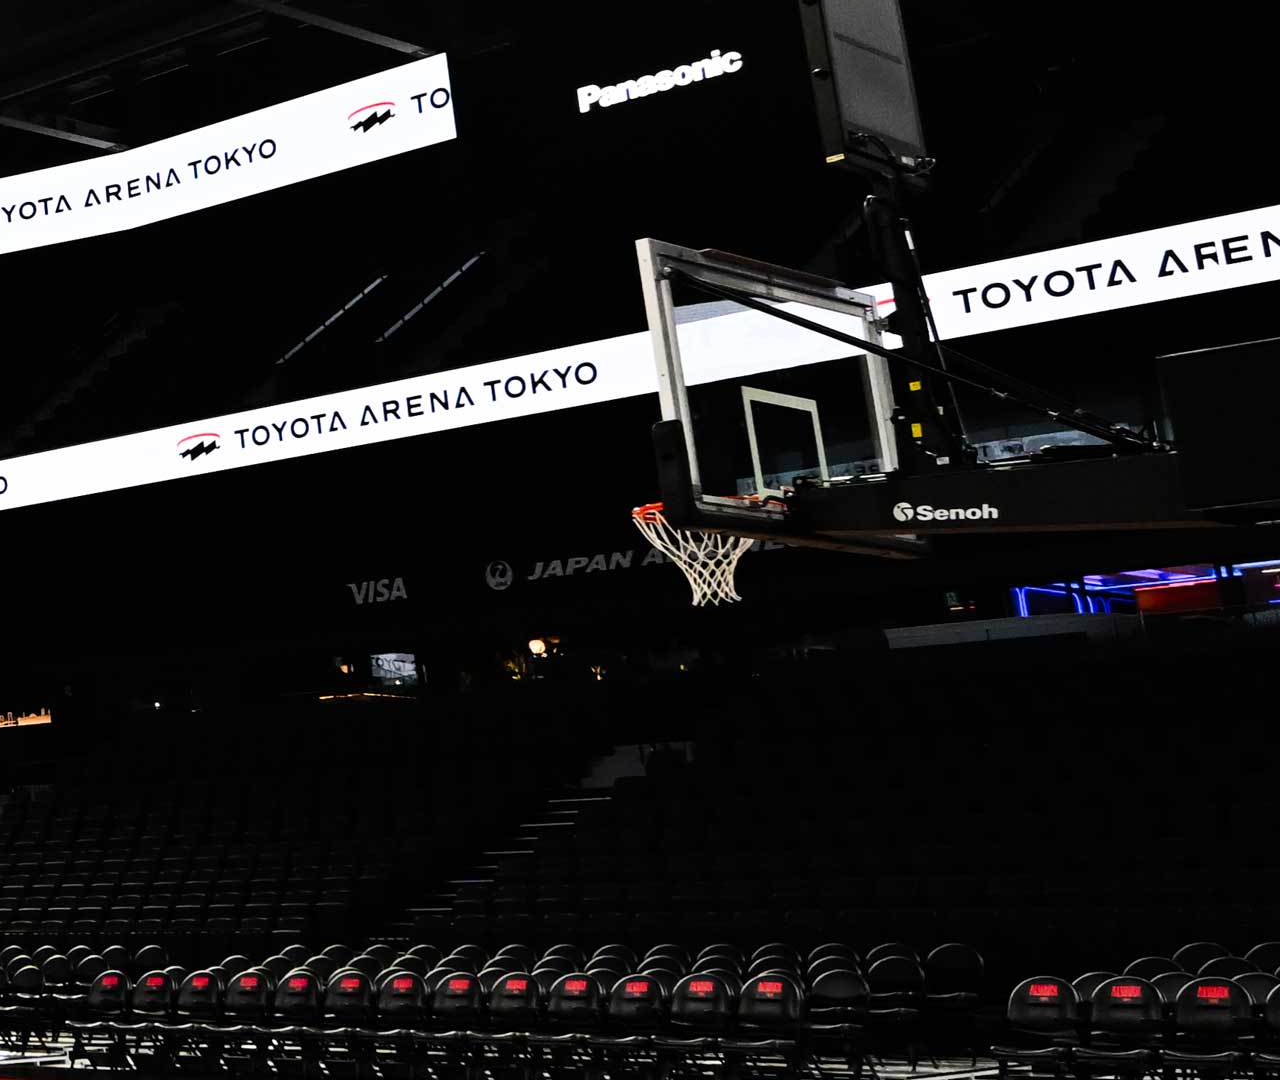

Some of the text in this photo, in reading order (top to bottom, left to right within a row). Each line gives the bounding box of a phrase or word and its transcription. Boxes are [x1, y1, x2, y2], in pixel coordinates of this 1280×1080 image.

[576, 49, 743, 114] Panasonic
[84, 167, 181, 208] ARENA
[187, 138, 277, 179] TOKYO
[952, 259, 1137, 314] TOYOTA
[233, 361, 598, 449] TOYOTA ARENA TOKYO
[916, 504, 999, 521] Senoh
[345, 576, 409, 606] VISA
[528, 550, 633, 580] JAPAN
